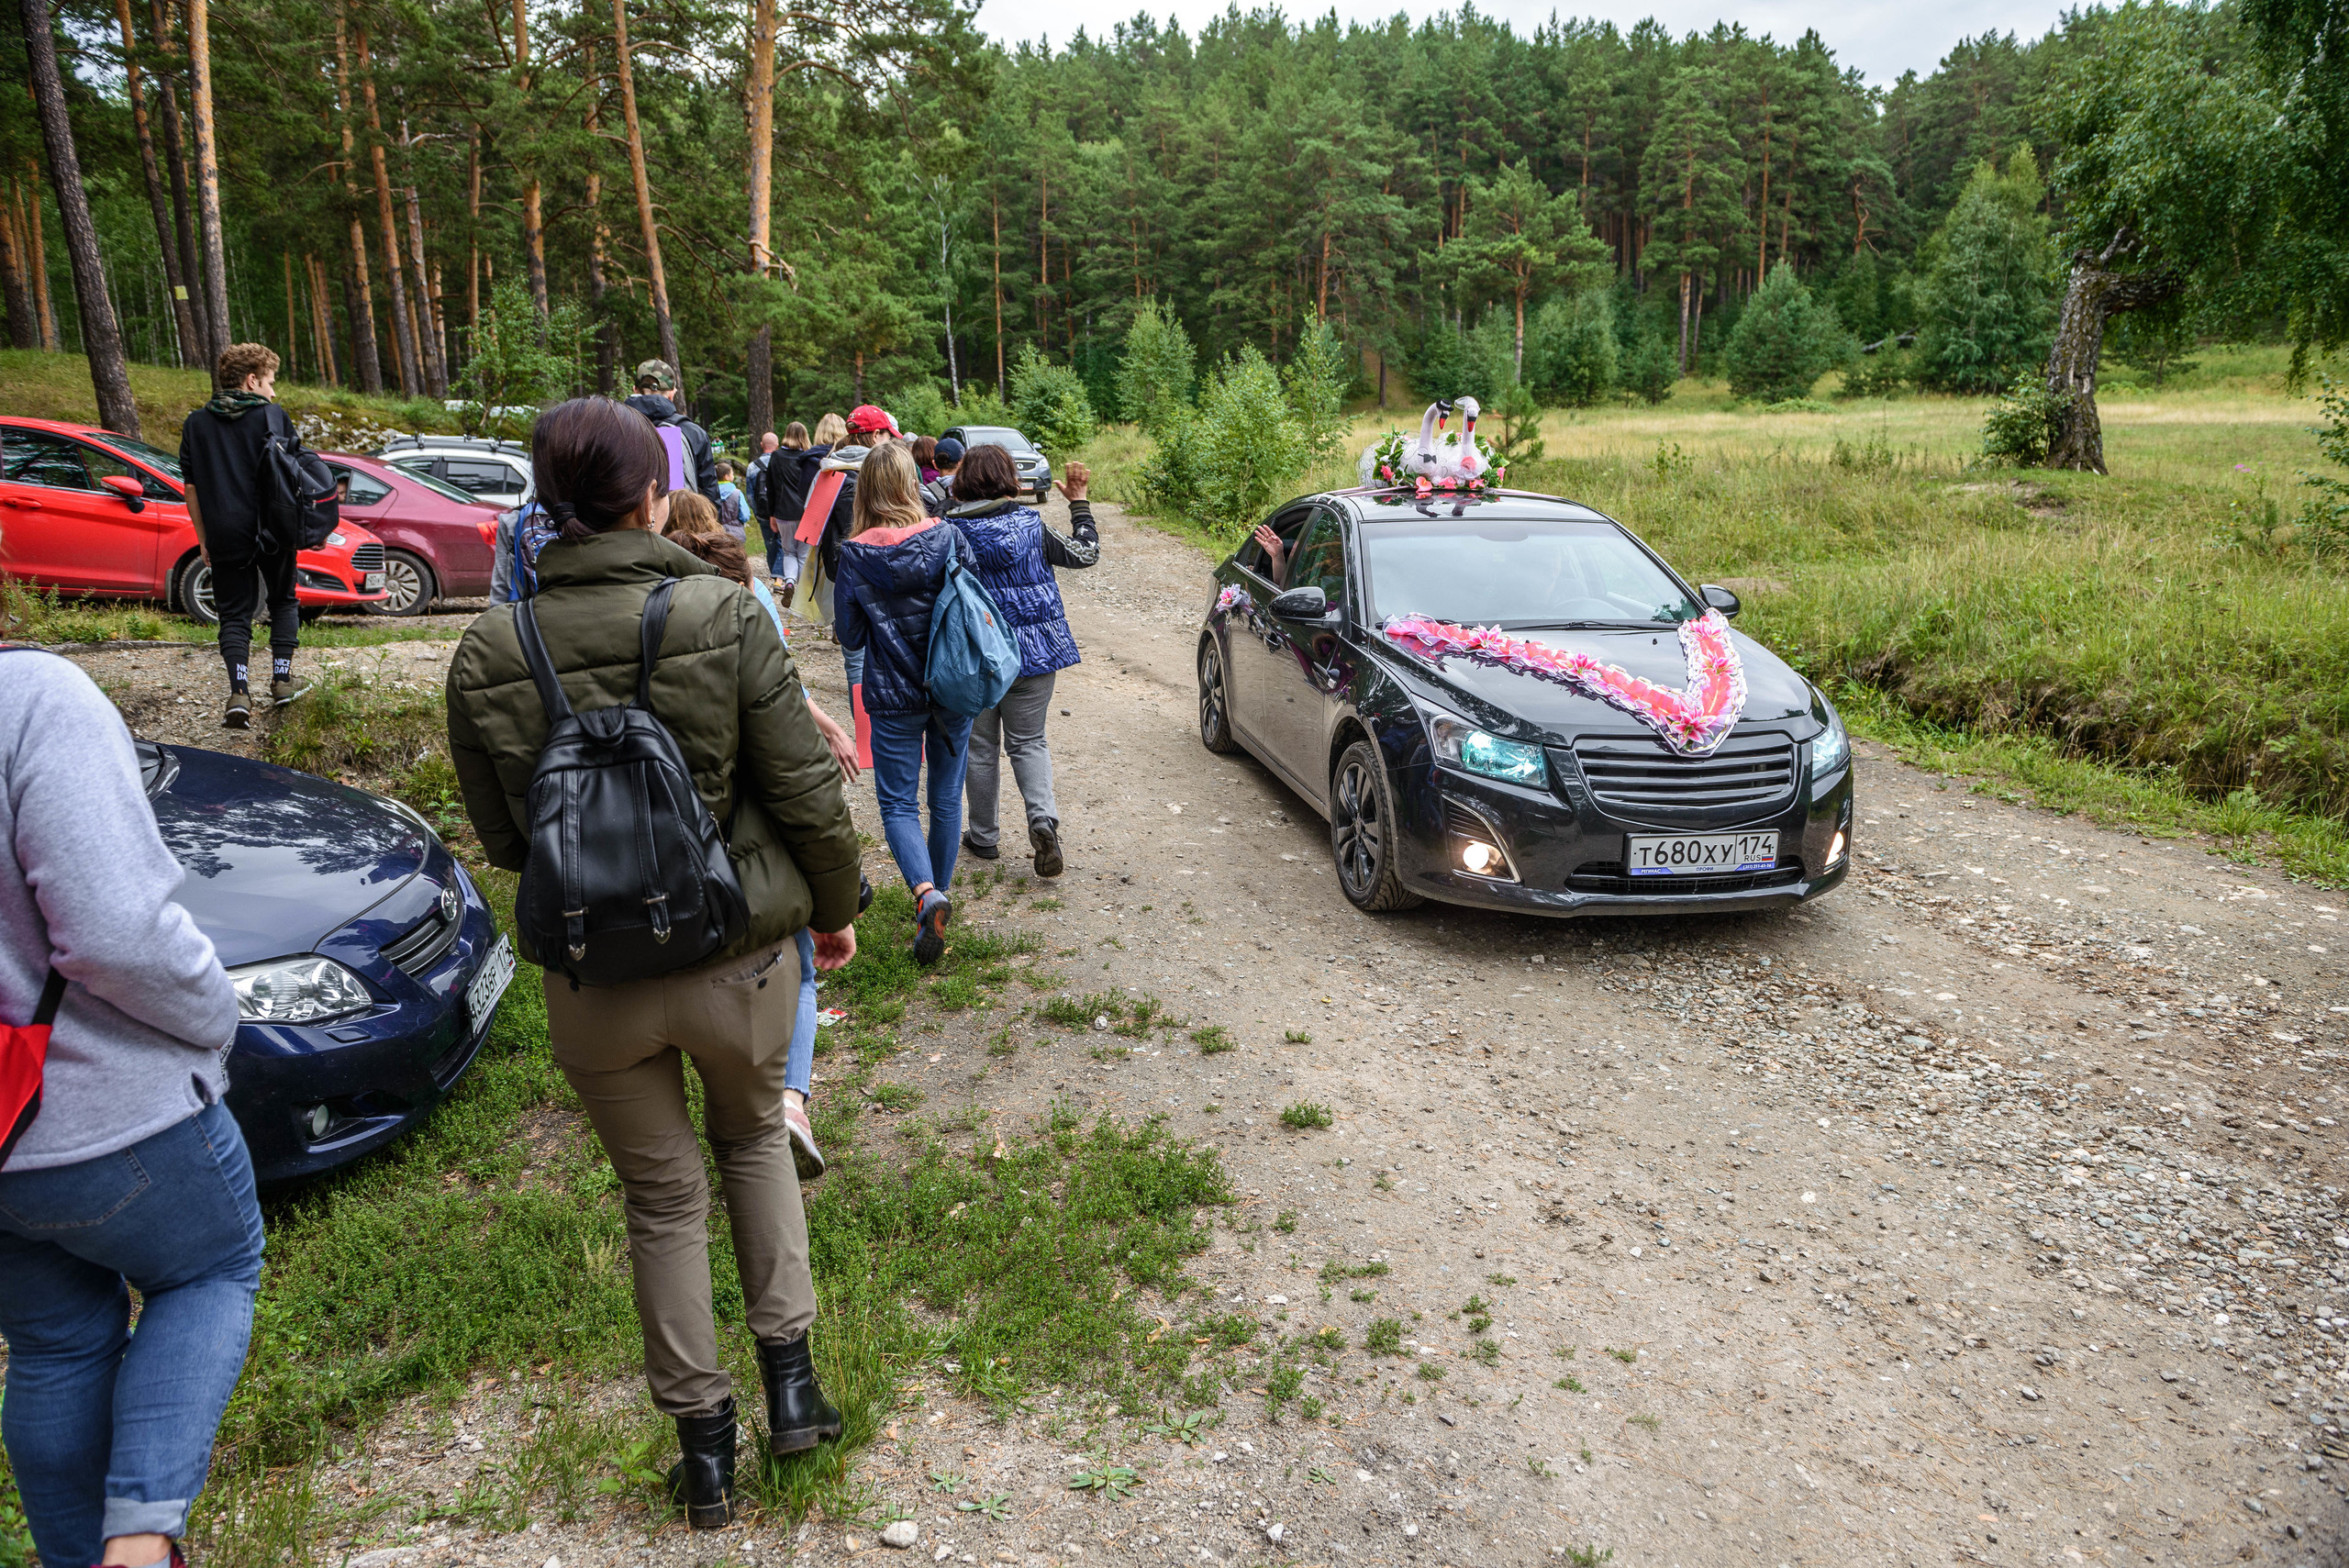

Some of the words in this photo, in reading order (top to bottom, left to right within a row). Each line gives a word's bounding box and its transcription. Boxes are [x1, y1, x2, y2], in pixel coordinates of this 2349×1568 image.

[237, 663, 248, 673] NIC
[274, 659, 291, 667] NICE
[237, 672, 248, 682] DA
[1738, 835, 1772, 854] 174
